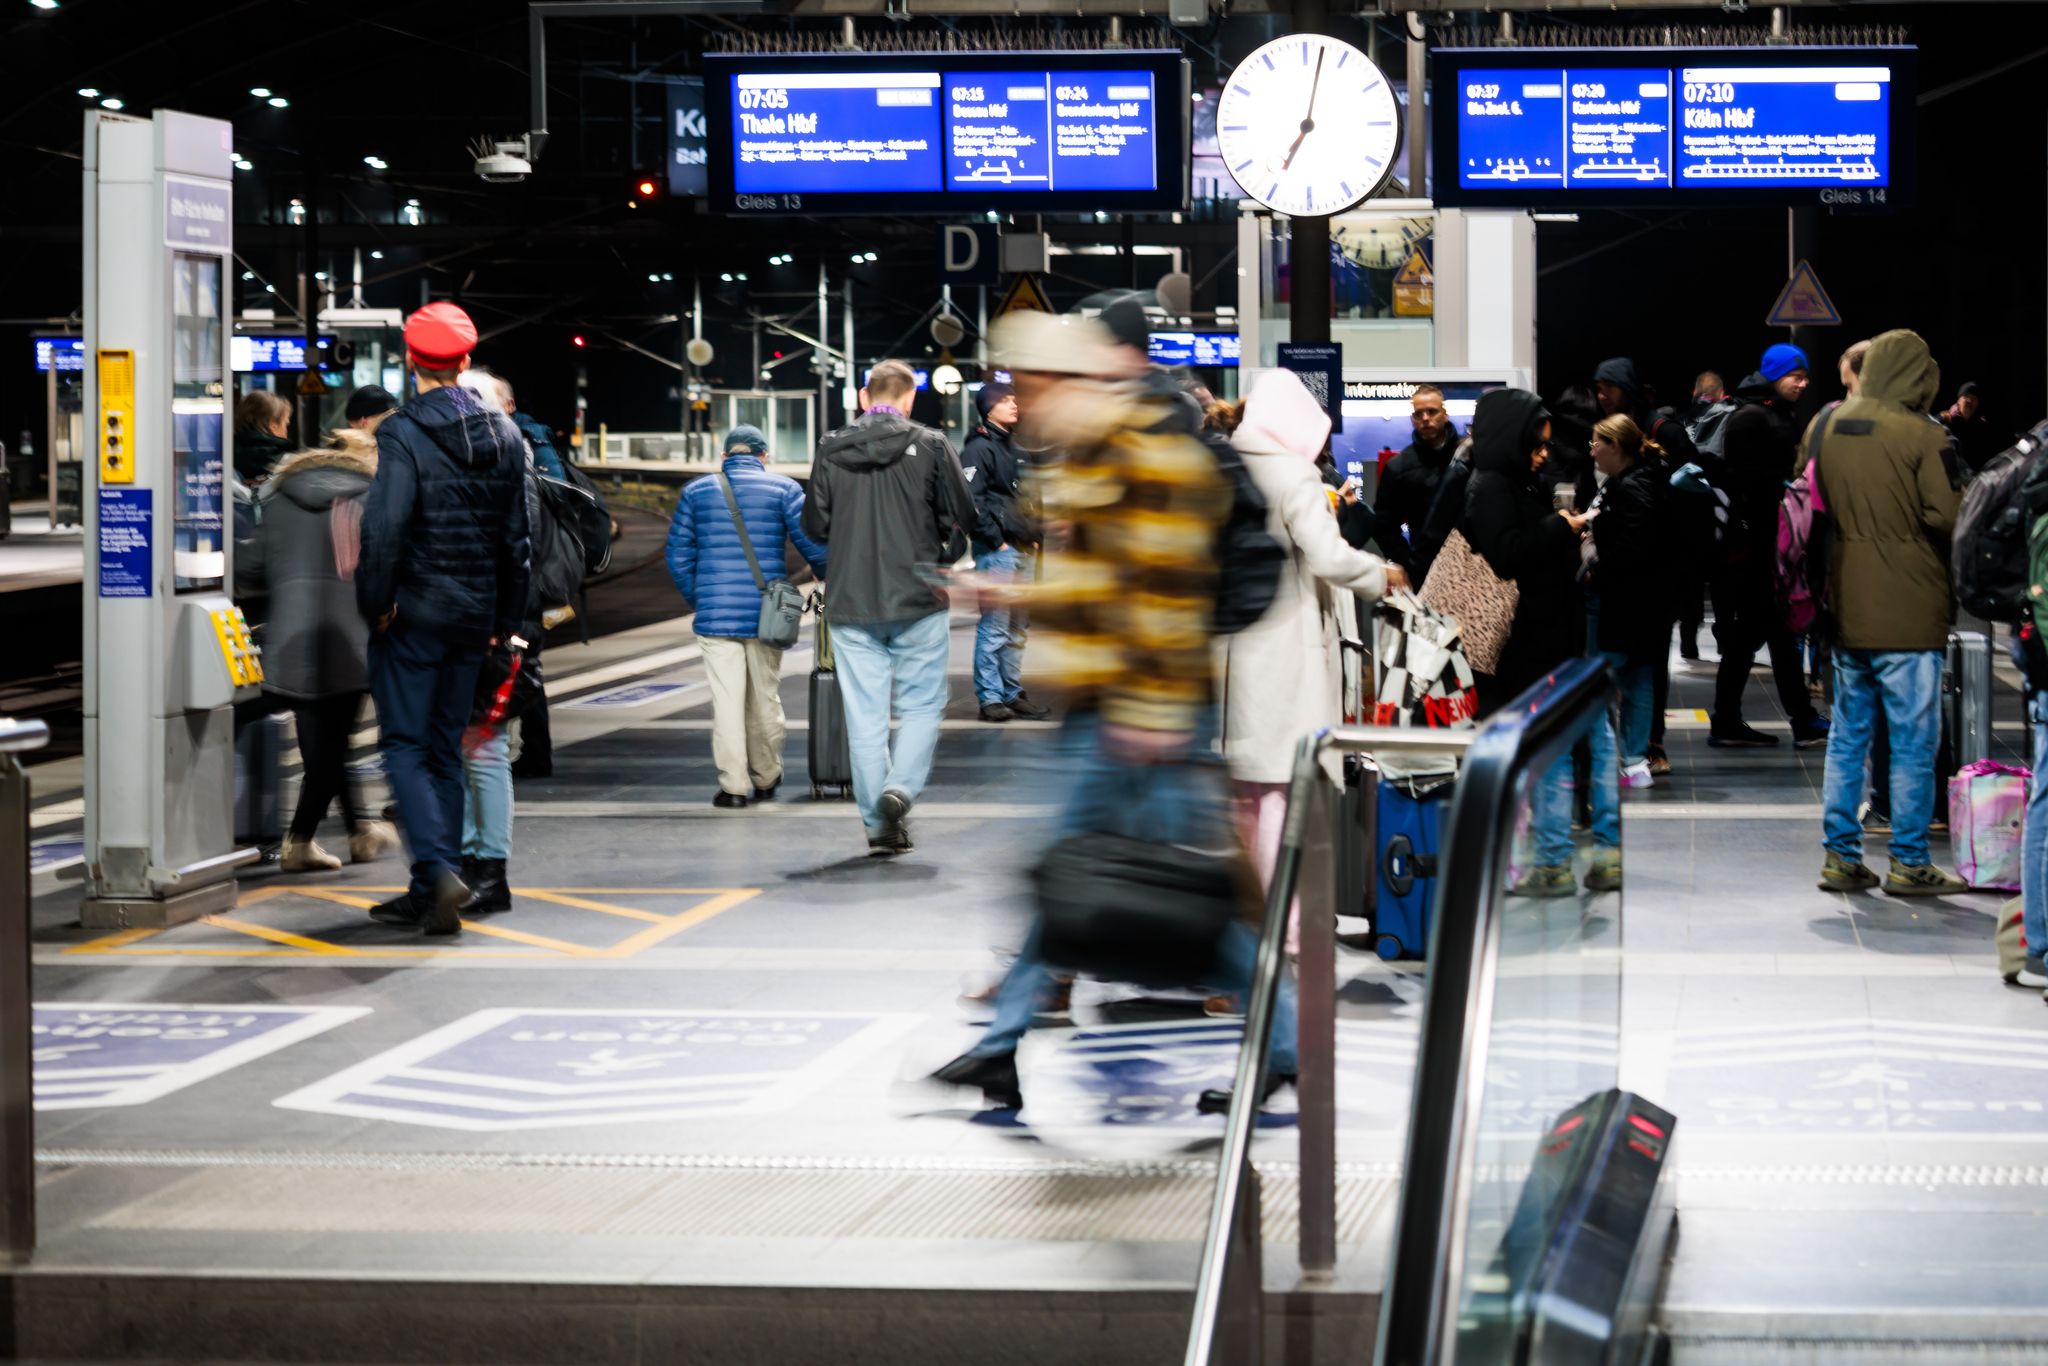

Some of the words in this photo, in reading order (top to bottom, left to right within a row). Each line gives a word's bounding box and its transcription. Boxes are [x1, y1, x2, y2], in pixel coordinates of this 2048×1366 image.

[738, 88, 789, 109] 07:05
[1466, 84, 1500, 99] 07:37
[1683, 83, 1735, 103] 07:10
[739, 113, 786, 134] Thale
[787, 112, 818, 134] Hbf
[1684, 107, 1722, 128] Köln
[1724, 106, 1756, 128] Hbf
[735, 193, 777, 209] Gleis
[782, 193, 802, 209] 13
[1819, 188, 1862, 204] Gleis
[1867, 188, 1887, 204] 14
[944, 224, 980, 272] D
